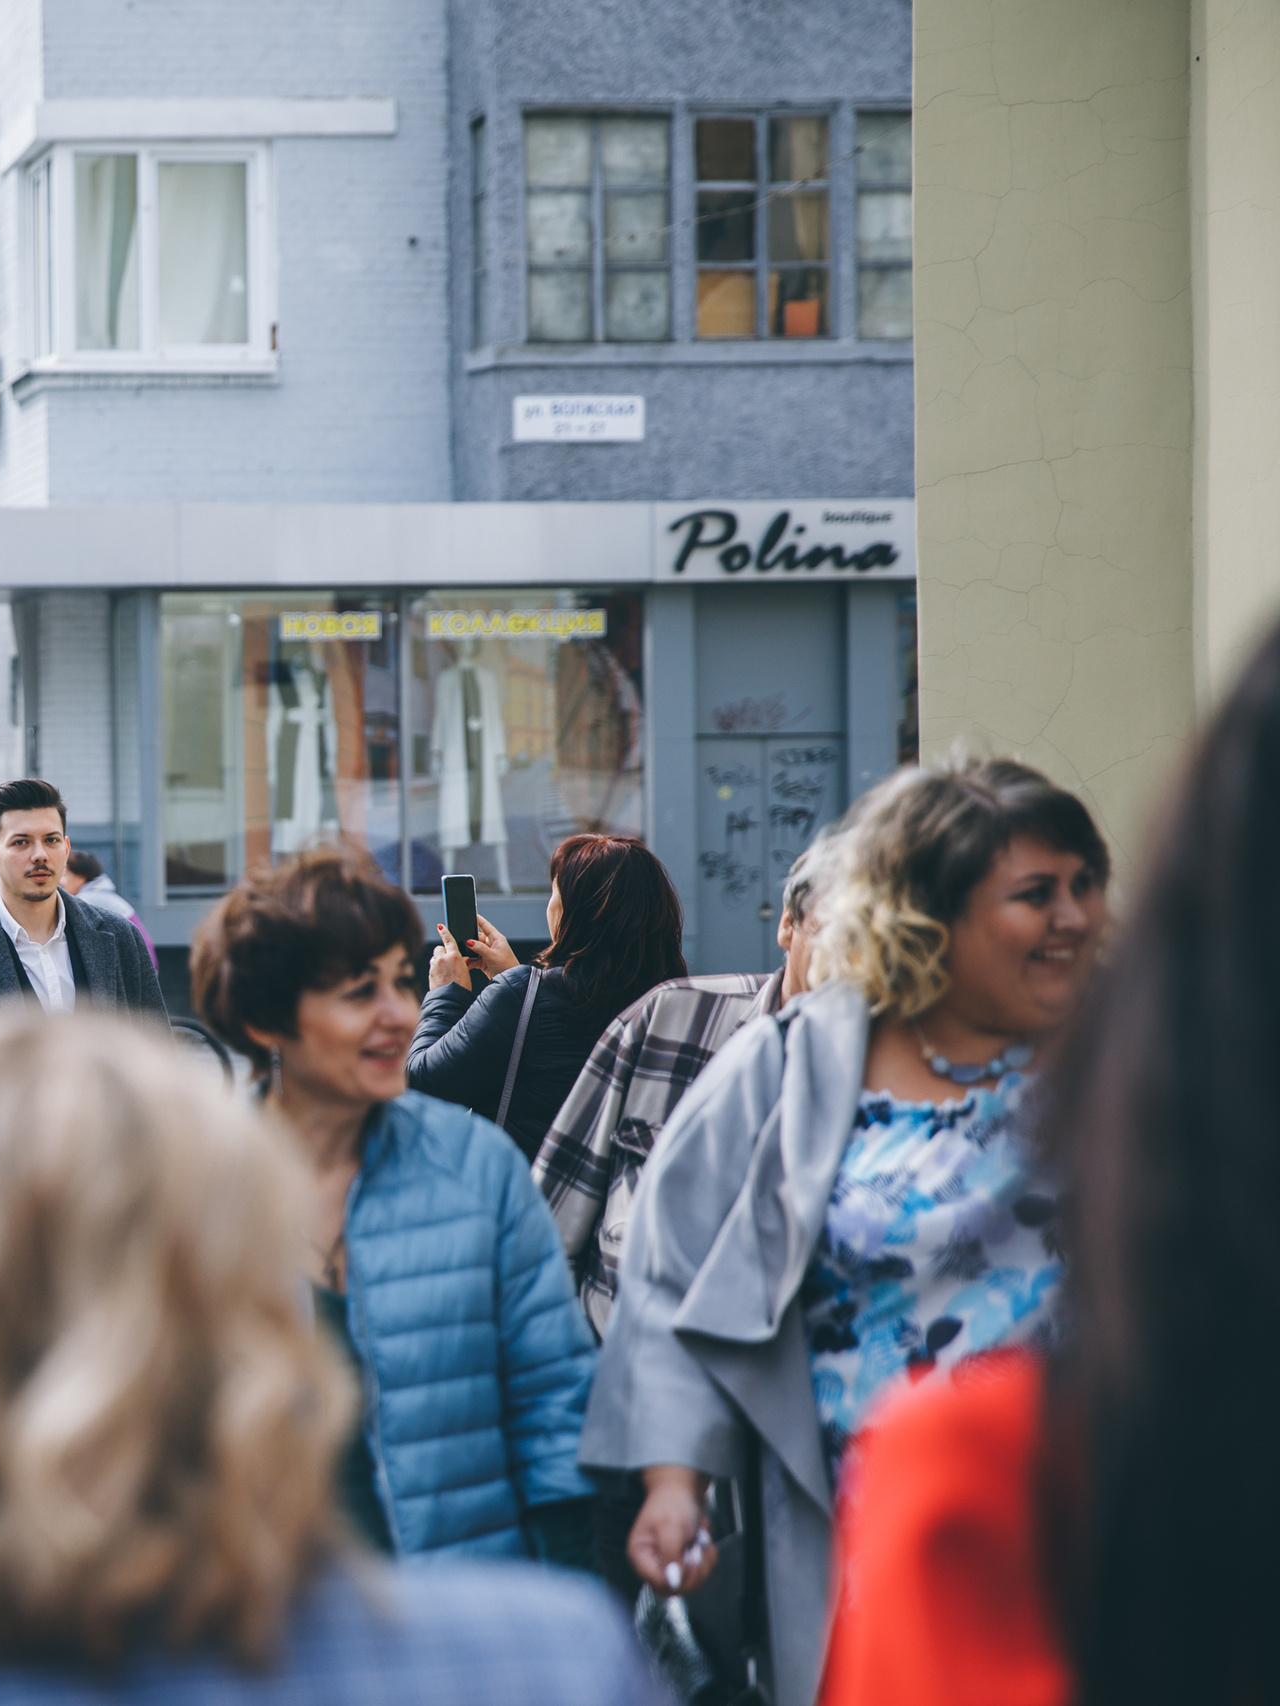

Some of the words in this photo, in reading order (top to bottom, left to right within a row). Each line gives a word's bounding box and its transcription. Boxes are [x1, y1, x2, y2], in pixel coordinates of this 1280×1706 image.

[822, 509, 895, 525] boutique
[668, 510, 900, 573] Polina
[428, 610, 605, 639] КОЛЛЕКЦИЯ
